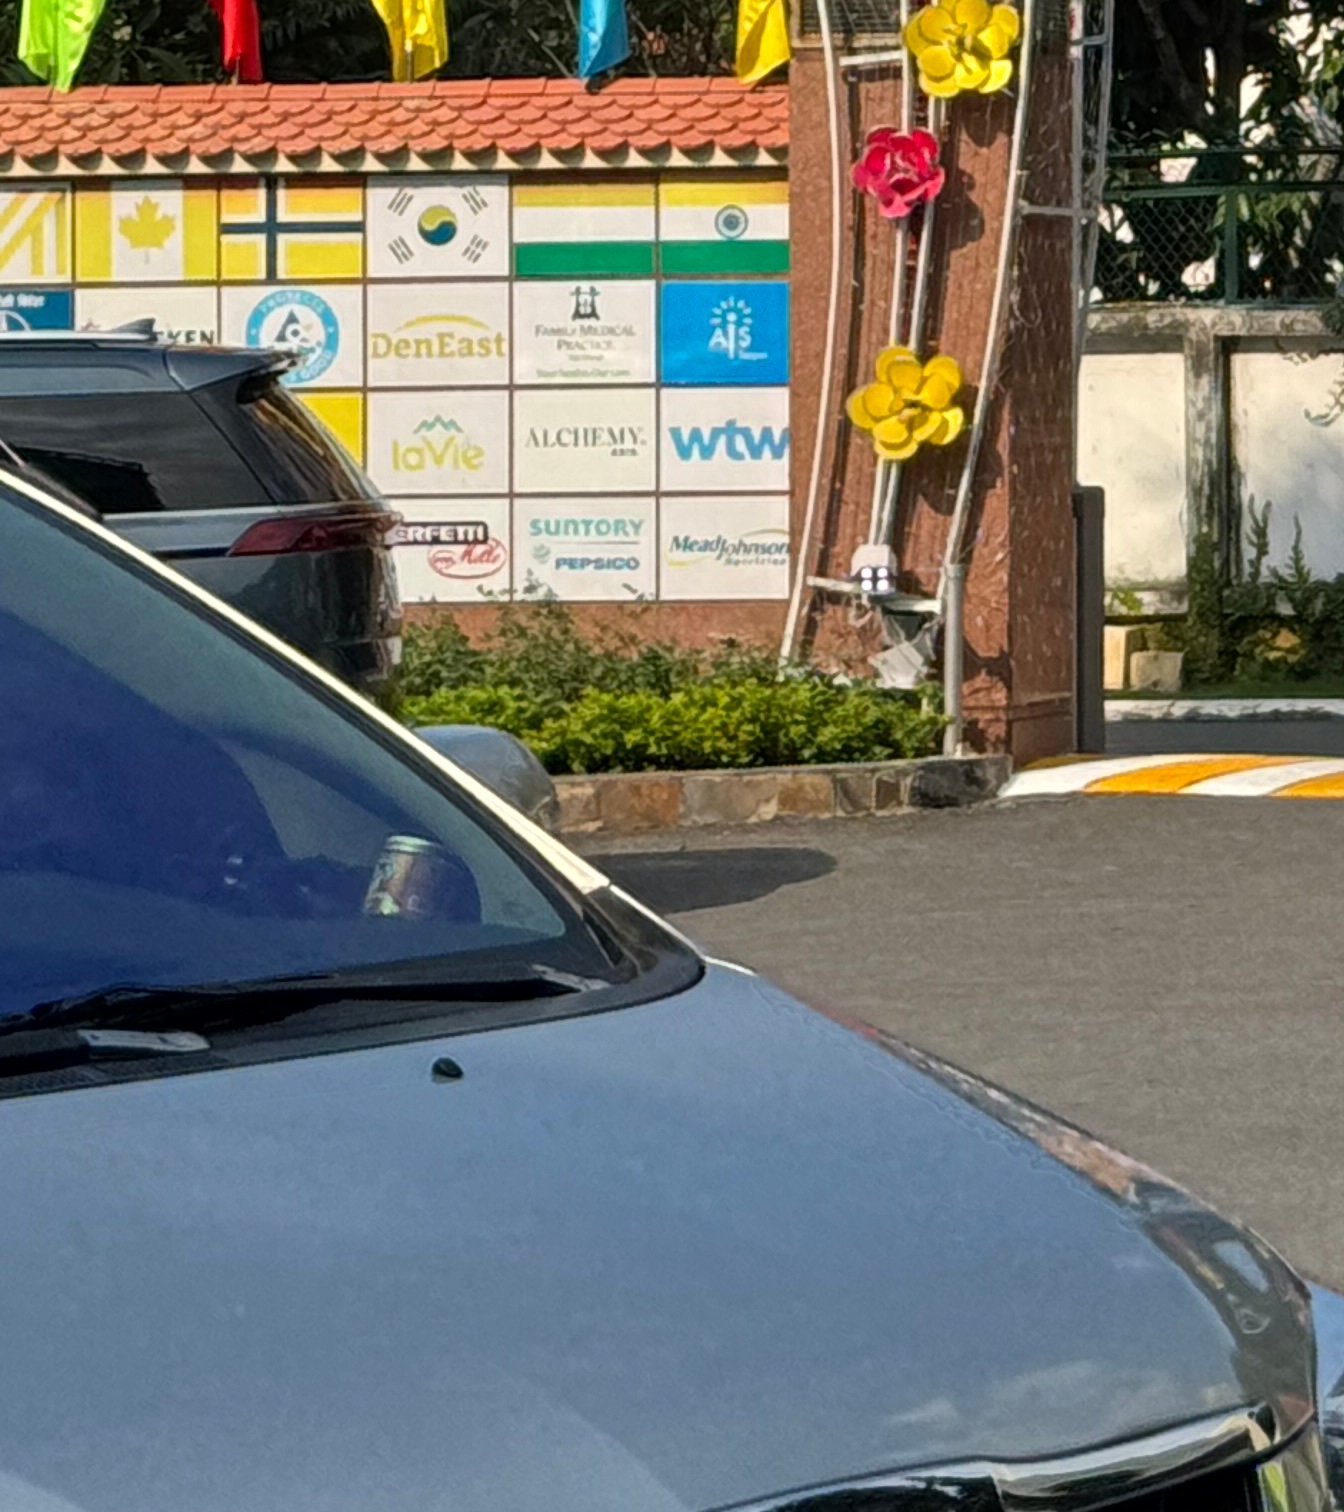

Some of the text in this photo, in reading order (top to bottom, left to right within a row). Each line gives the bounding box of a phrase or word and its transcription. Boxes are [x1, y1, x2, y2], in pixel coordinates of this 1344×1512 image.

[371, 332, 506, 359] DenEast
[384, 524, 485, 542] ERFETTI
[555, 557, 640, 570] PEPSICO
